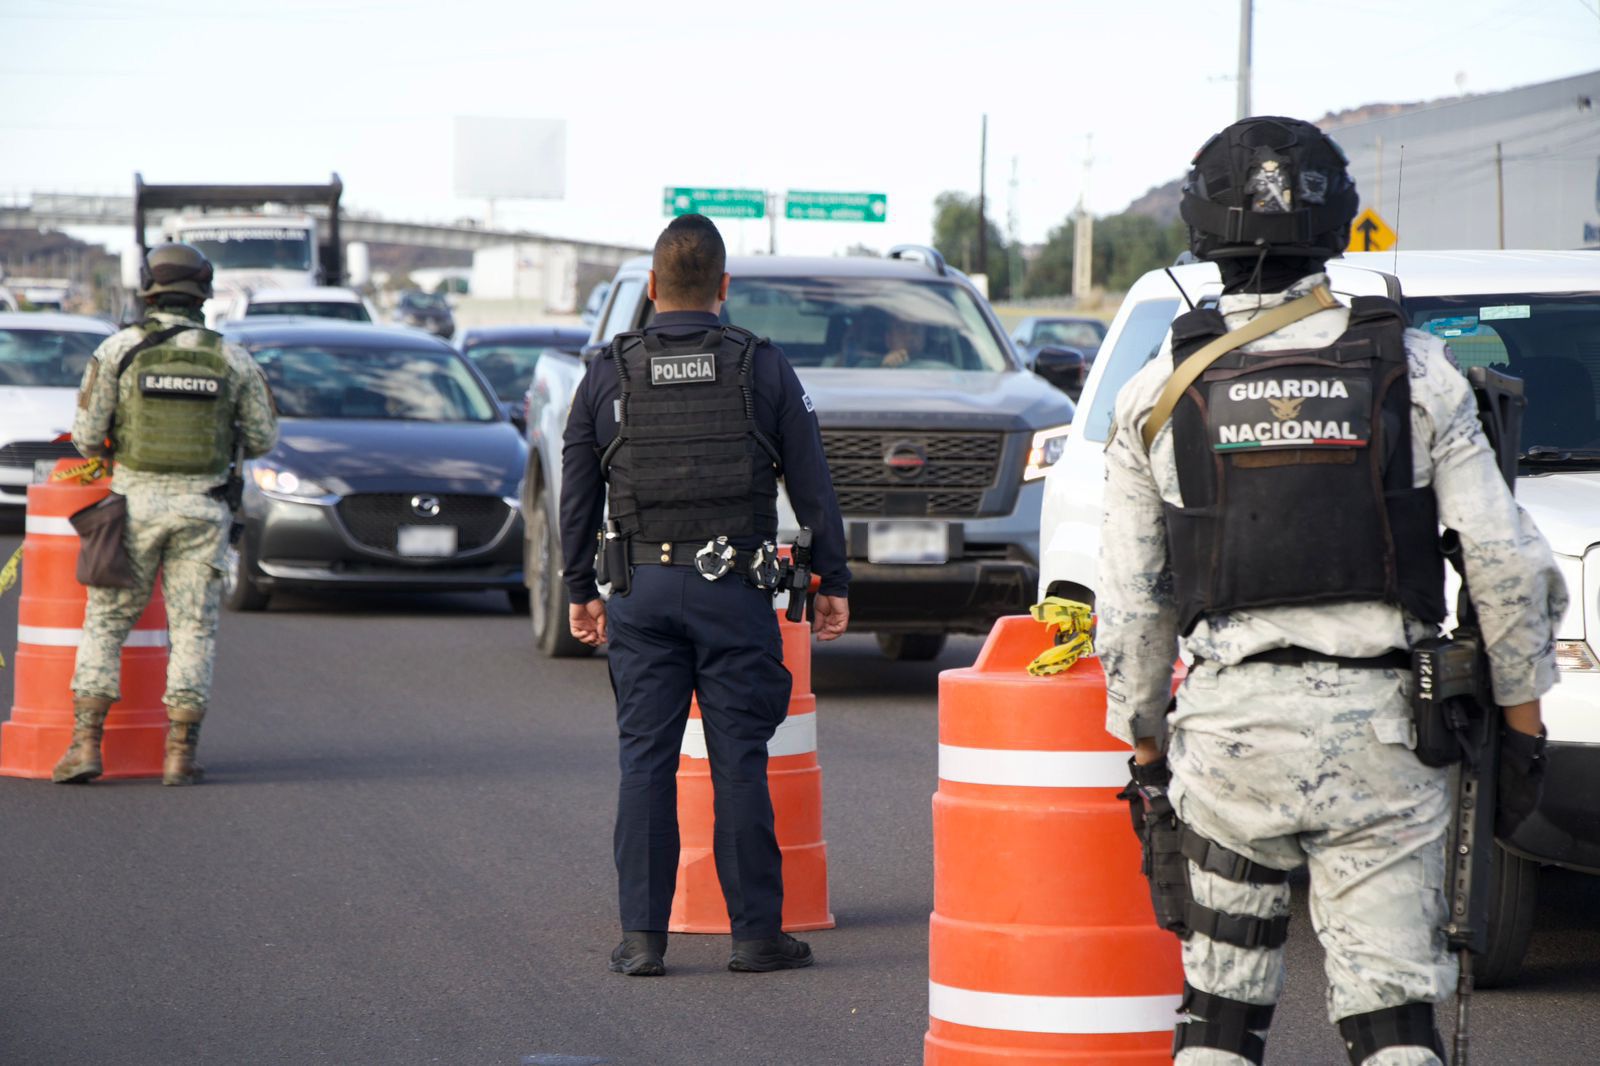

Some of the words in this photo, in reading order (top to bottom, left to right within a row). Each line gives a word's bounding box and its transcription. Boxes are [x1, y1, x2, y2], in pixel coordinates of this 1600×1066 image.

[653, 359, 712, 380] POLICÍA
[1228, 379, 1349, 401] GUARDIA
[1218, 420, 1358, 444] NACIONAL
